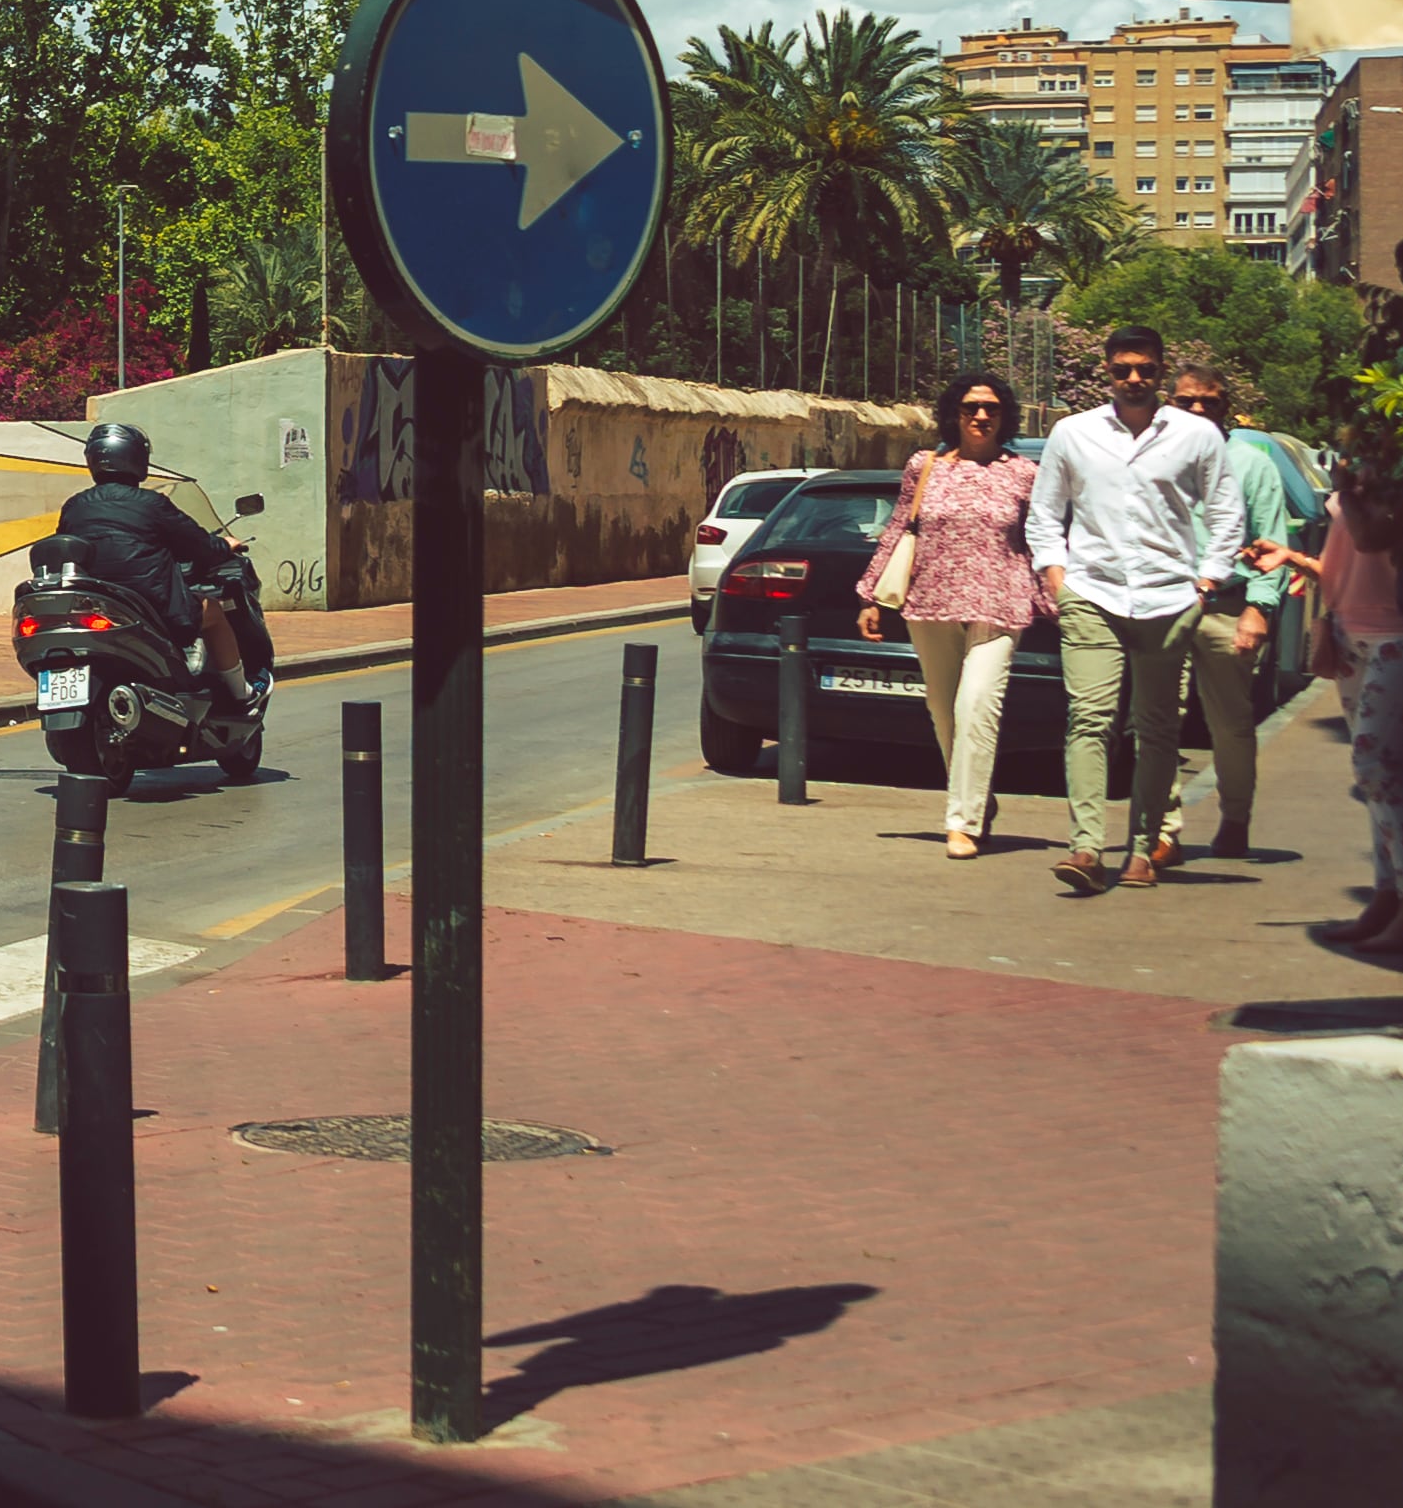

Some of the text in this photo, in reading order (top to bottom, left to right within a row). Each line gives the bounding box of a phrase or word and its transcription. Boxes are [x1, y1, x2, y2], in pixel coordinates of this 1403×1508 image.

[50, 669, 86, 686] 2535
[838, 669, 927, 693] 2514 C
[51, 685, 78, 701] FDG
